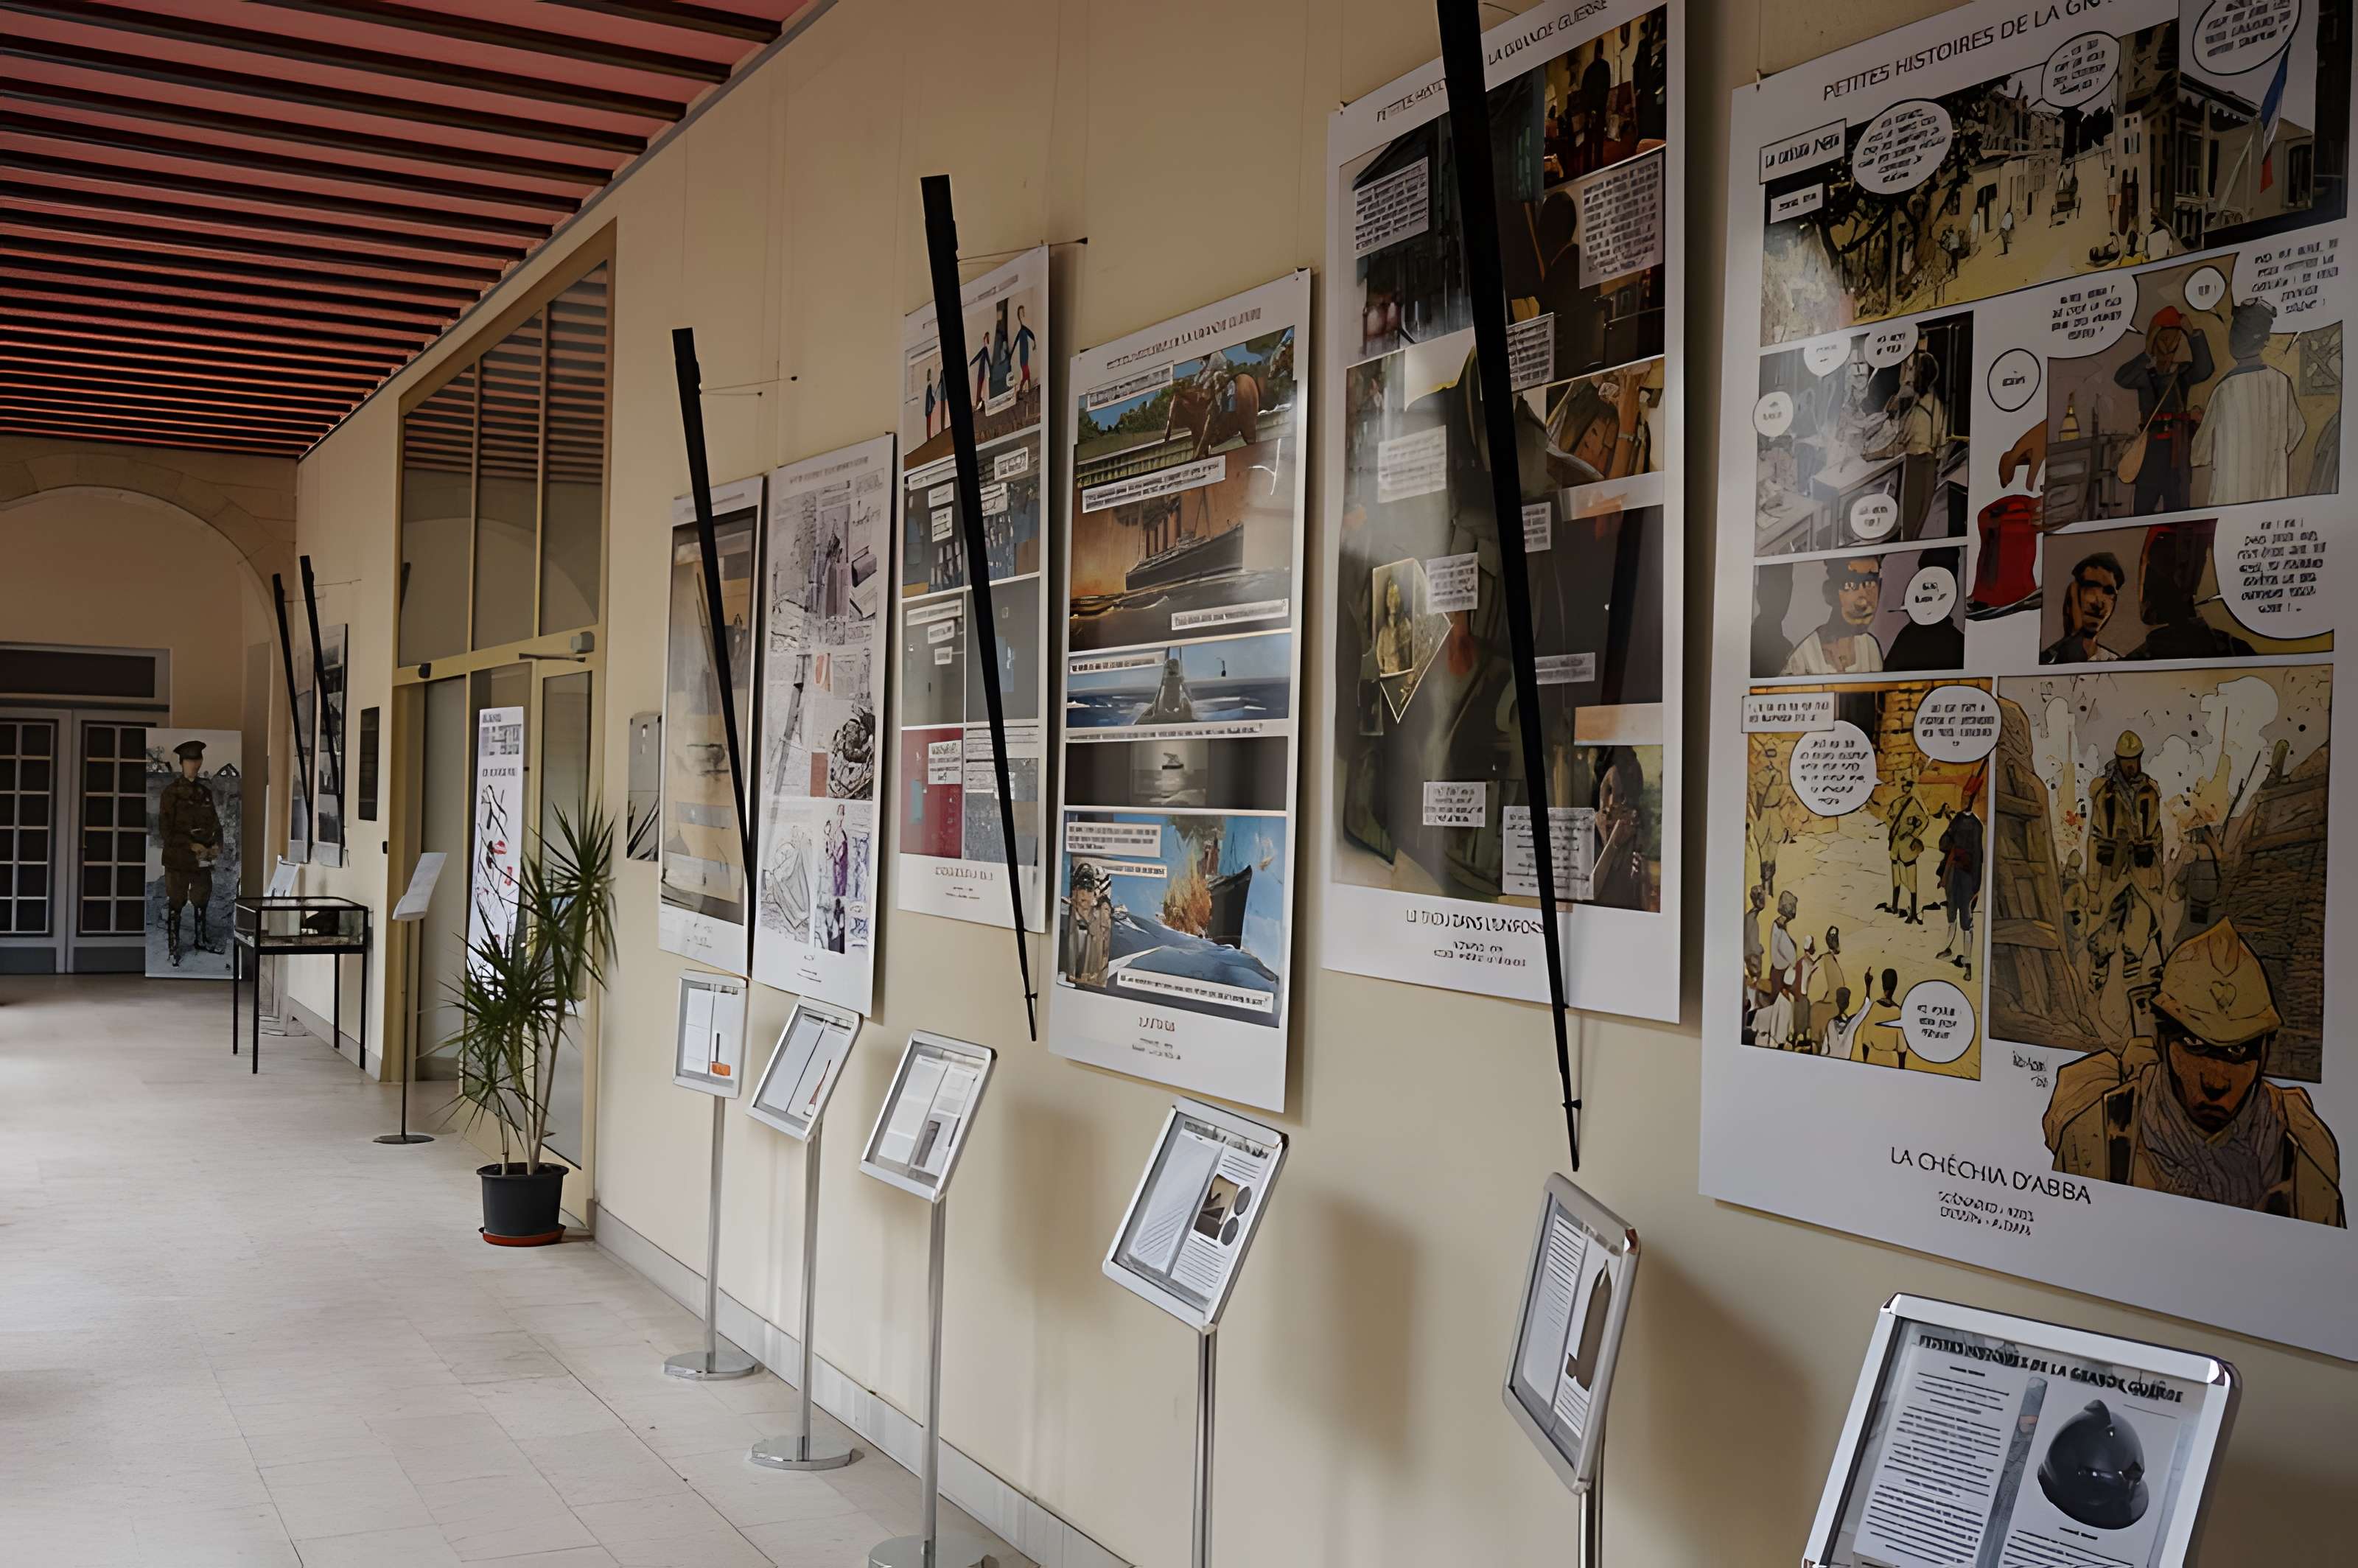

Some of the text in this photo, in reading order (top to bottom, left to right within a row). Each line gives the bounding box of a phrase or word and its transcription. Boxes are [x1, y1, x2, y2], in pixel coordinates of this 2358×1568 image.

[1824, 63, 1890, 100] PETITES
[1896, 27, 1994, 77] HISTOIRES
[2001, 14, 2029, 39] DE
[2035, 6, 2060, 28] LA
[1892, 1147, 2092, 1205] LA CHÉCHIA D'ABBA
